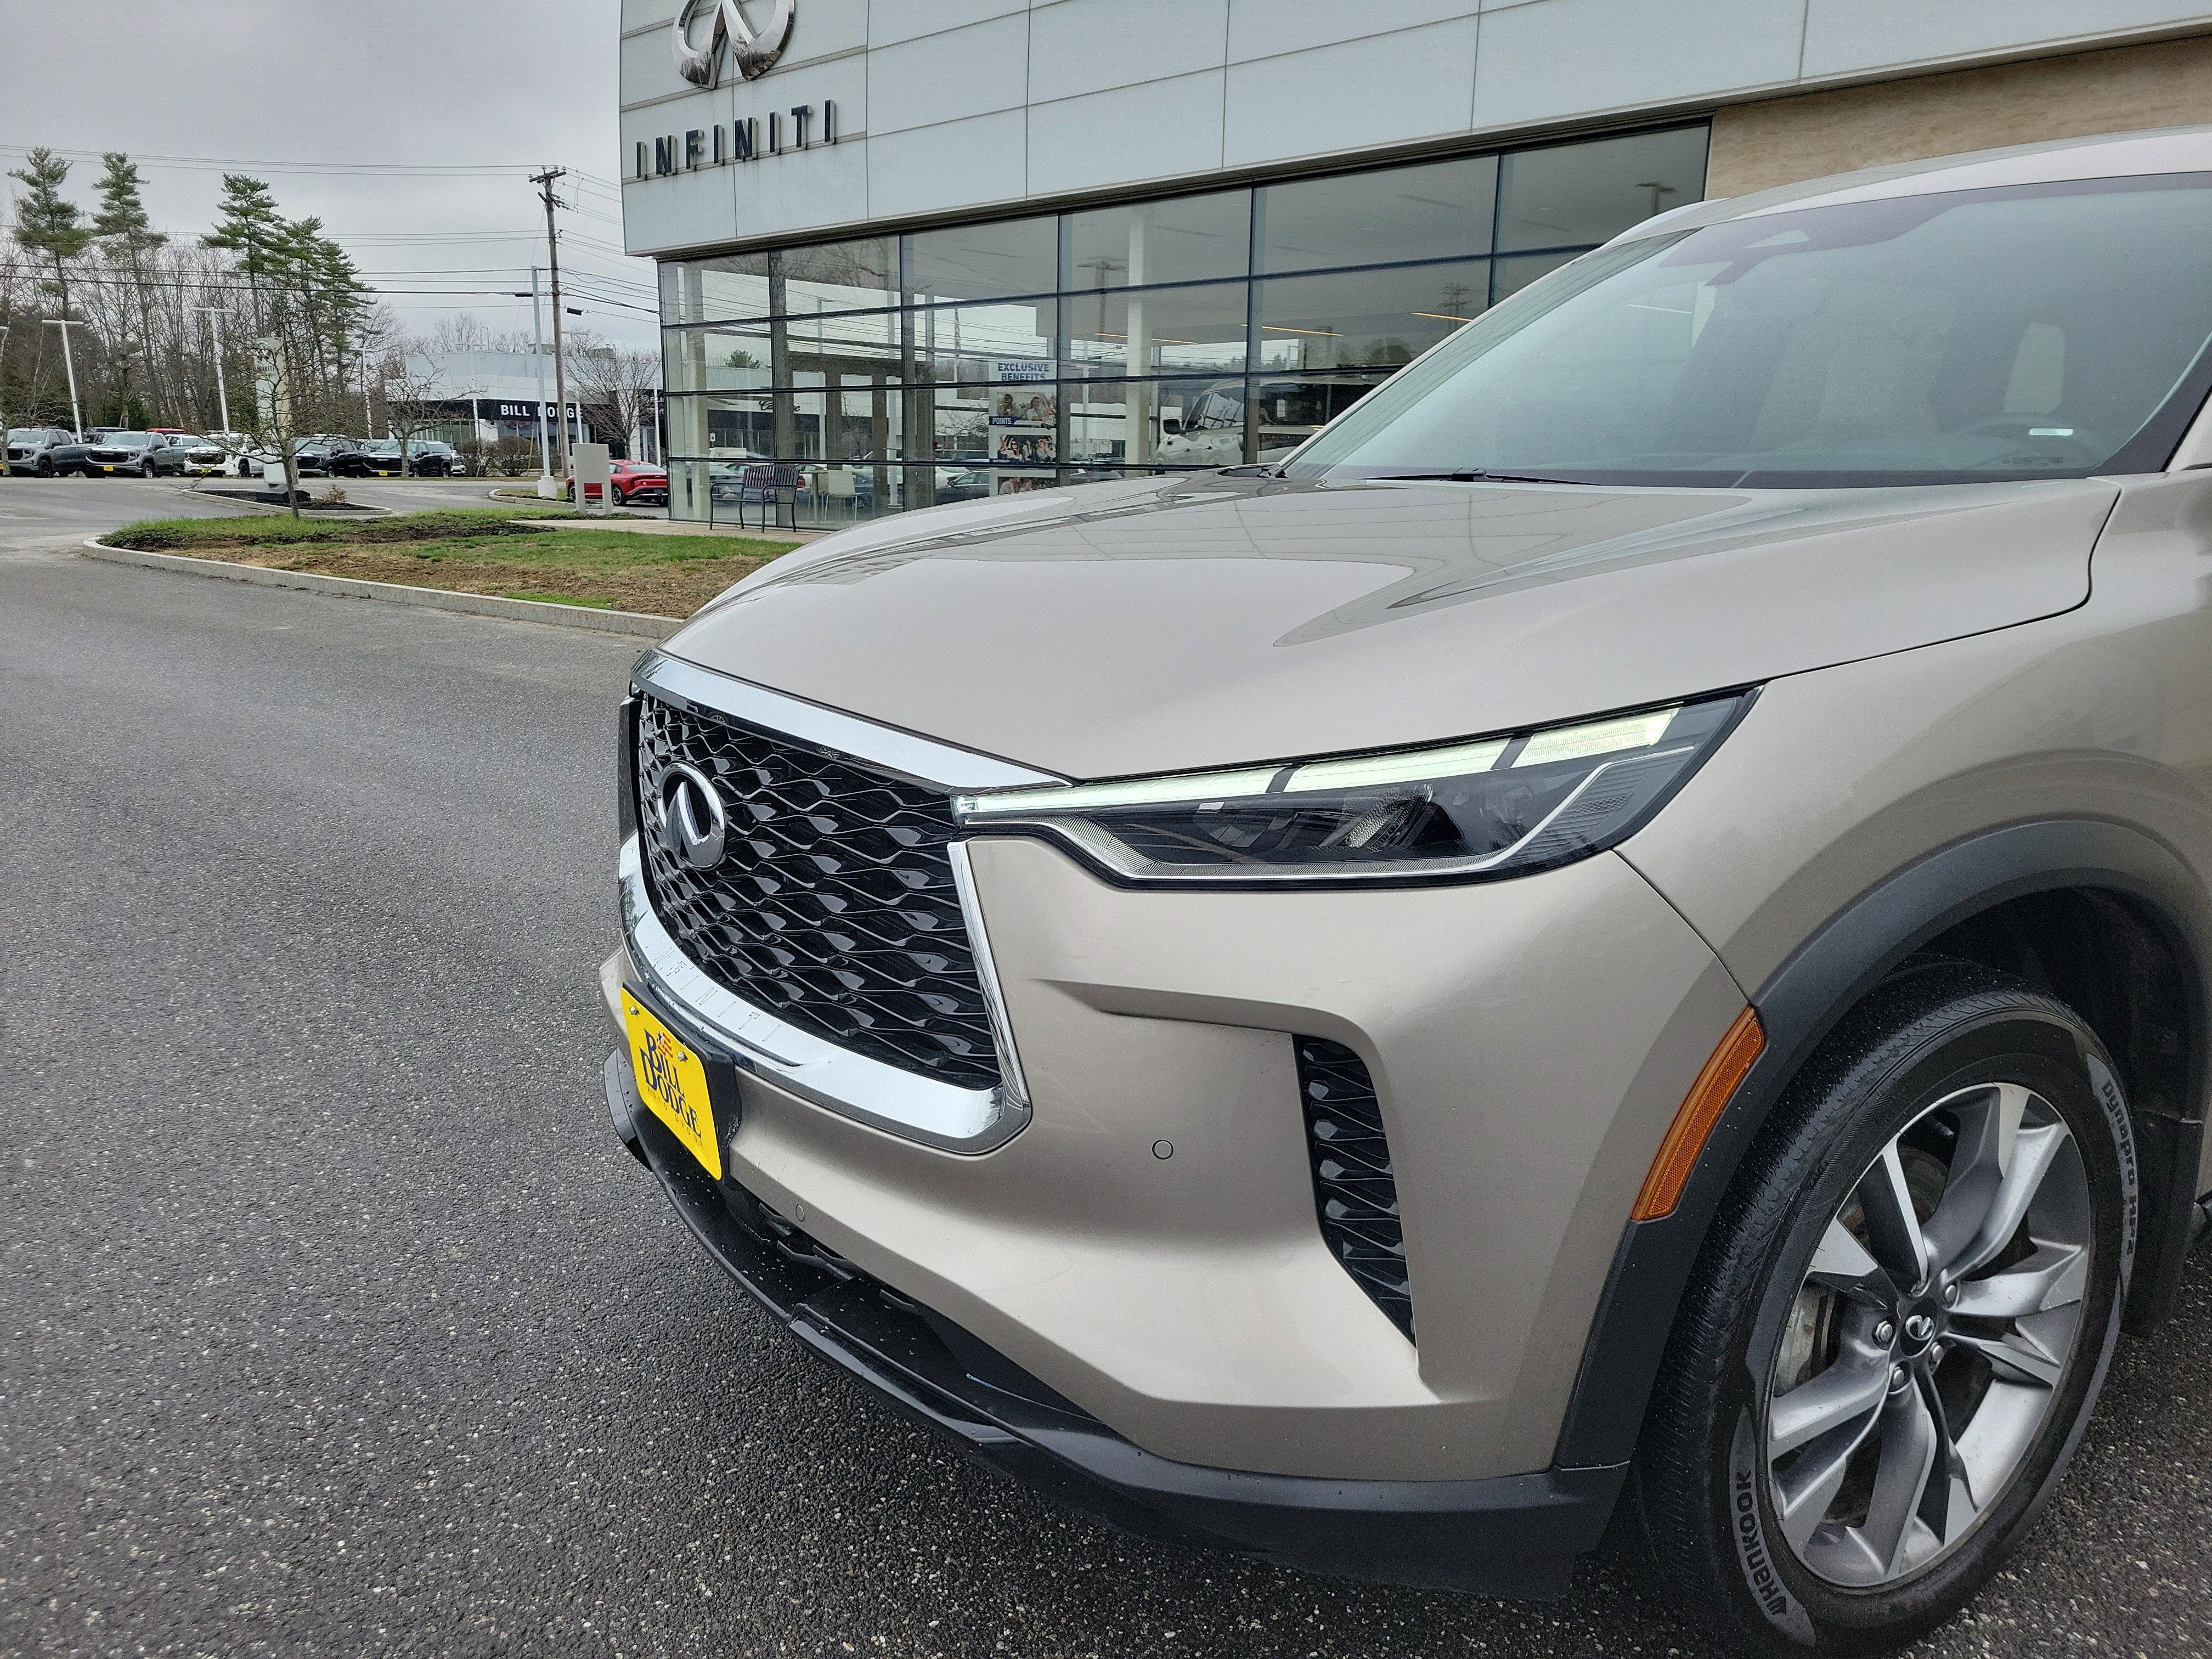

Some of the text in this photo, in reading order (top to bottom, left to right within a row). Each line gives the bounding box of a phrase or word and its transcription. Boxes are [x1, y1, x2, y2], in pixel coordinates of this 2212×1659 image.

[636, 99, 834, 178] INFINITI
[500, 404, 530, 416] BILL
[998, 363, 1049, 371] EXCLUSIVE
[646, 934, 781, 1042] INFINITI
[639, 1046, 702, 1139] DODGE
[2102, 1079, 2135, 1186] Dynapro
